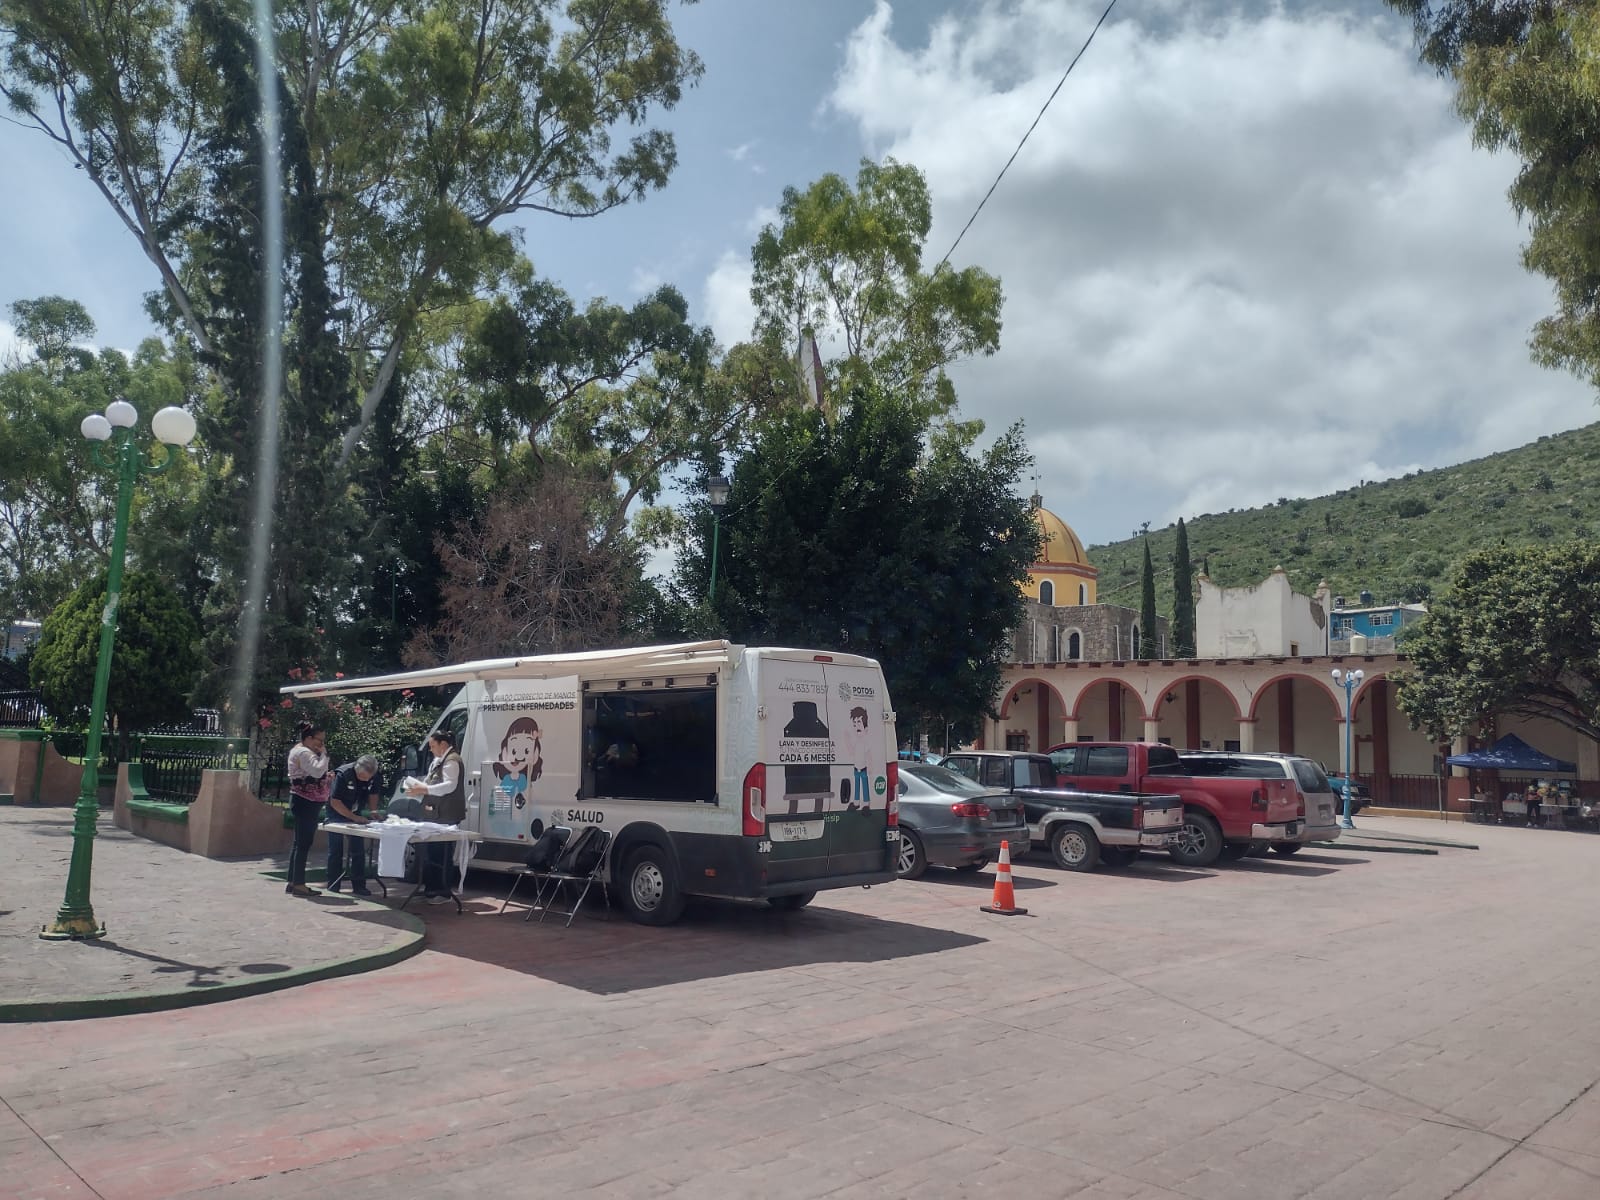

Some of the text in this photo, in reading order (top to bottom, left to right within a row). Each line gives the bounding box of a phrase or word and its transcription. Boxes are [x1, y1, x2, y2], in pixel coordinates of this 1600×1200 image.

[516, 701, 575, 711] ENFERMEDADES
[779, 753, 836, 762] CADA 6 MESES
[567, 809, 604, 824] SALUD
